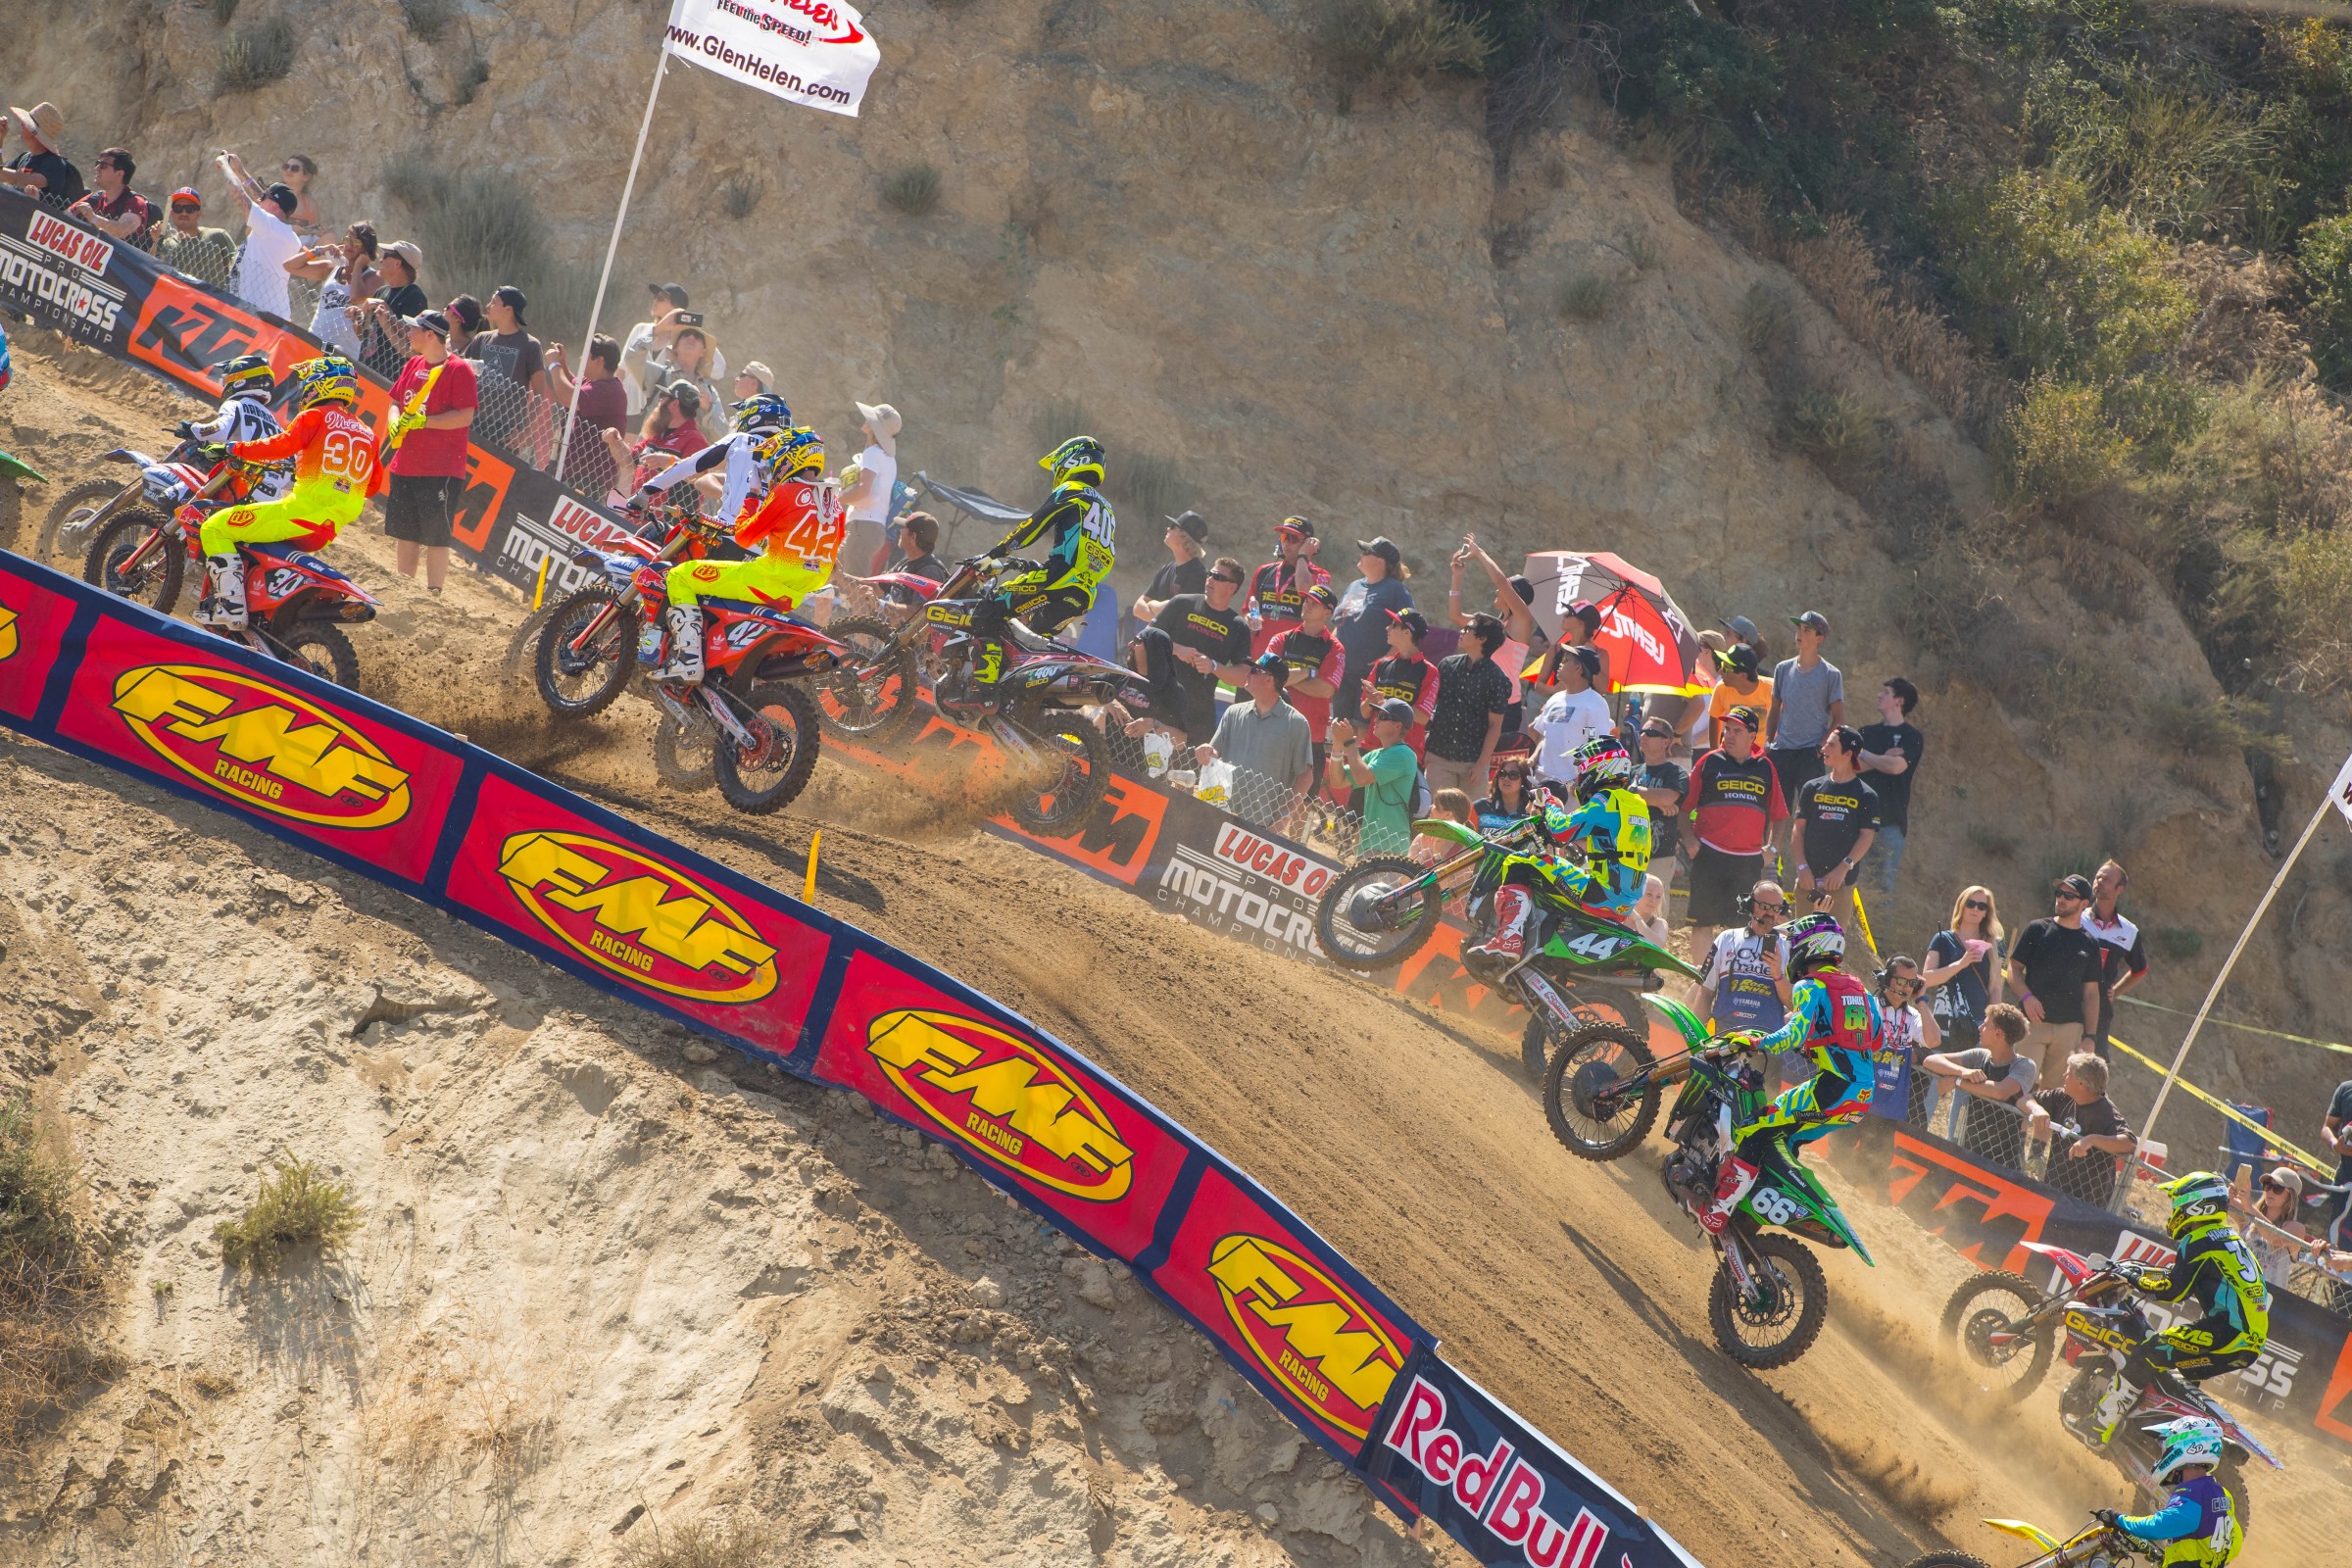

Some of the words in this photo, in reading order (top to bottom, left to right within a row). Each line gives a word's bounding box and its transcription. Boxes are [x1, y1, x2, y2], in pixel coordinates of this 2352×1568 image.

[29, 216, 84, 259] LUCAS
[79, 238, 110, 271] OIL
[43, 254, 80, 278] PRO
[321, 430, 374, 484] 30
[307, 561, 325, 573] KTM
[267, 567, 305, 597] 30
[1014, 594, 1049, 614] GEICO
[726, 619, 768, 647] 42
[1186, 612, 1229, 637] GEICO
[1025, 677, 1050, 689] GEICO
[111, 668, 413, 803] FMF
[214, 758, 284, 801] RACING
[1716, 779, 1766, 796] GEICO
[1724, 792, 1758, 803] HONDA
[1814, 793, 1859, 808] GEICO
[1818, 804, 1850, 814] HONDA
[1218, 828, 1306, 886] LUCAS
[1303, 868, 1339, 900] OI
[495, 835, 781, 976] FMF
[1244, 875, 1311, 911] PRO
[1156, 888, 1317, 967] CHAMPIONS
[589, 929, 655, 973] RACING
[1567, 932, 1621, 960] 44
[1726, 959, 1773, 976] Trade
[1739, 998, 1762, 1007] YAMAHA
[1843, 1005, 1869, 1031] 66
[864, 1012, 1138, 1174] FMF
[966, 1111, 1024, 1157] RACING
[1751, 1186, 1797, 1226] 66
[2185, 1198, 2218, 1216] 6D
[2068, 1329, 2090, 1345] HONDA
[2167, 1337, 2200, 1353] GEICO
[1277, 1348, 1330, 1403] RACING
